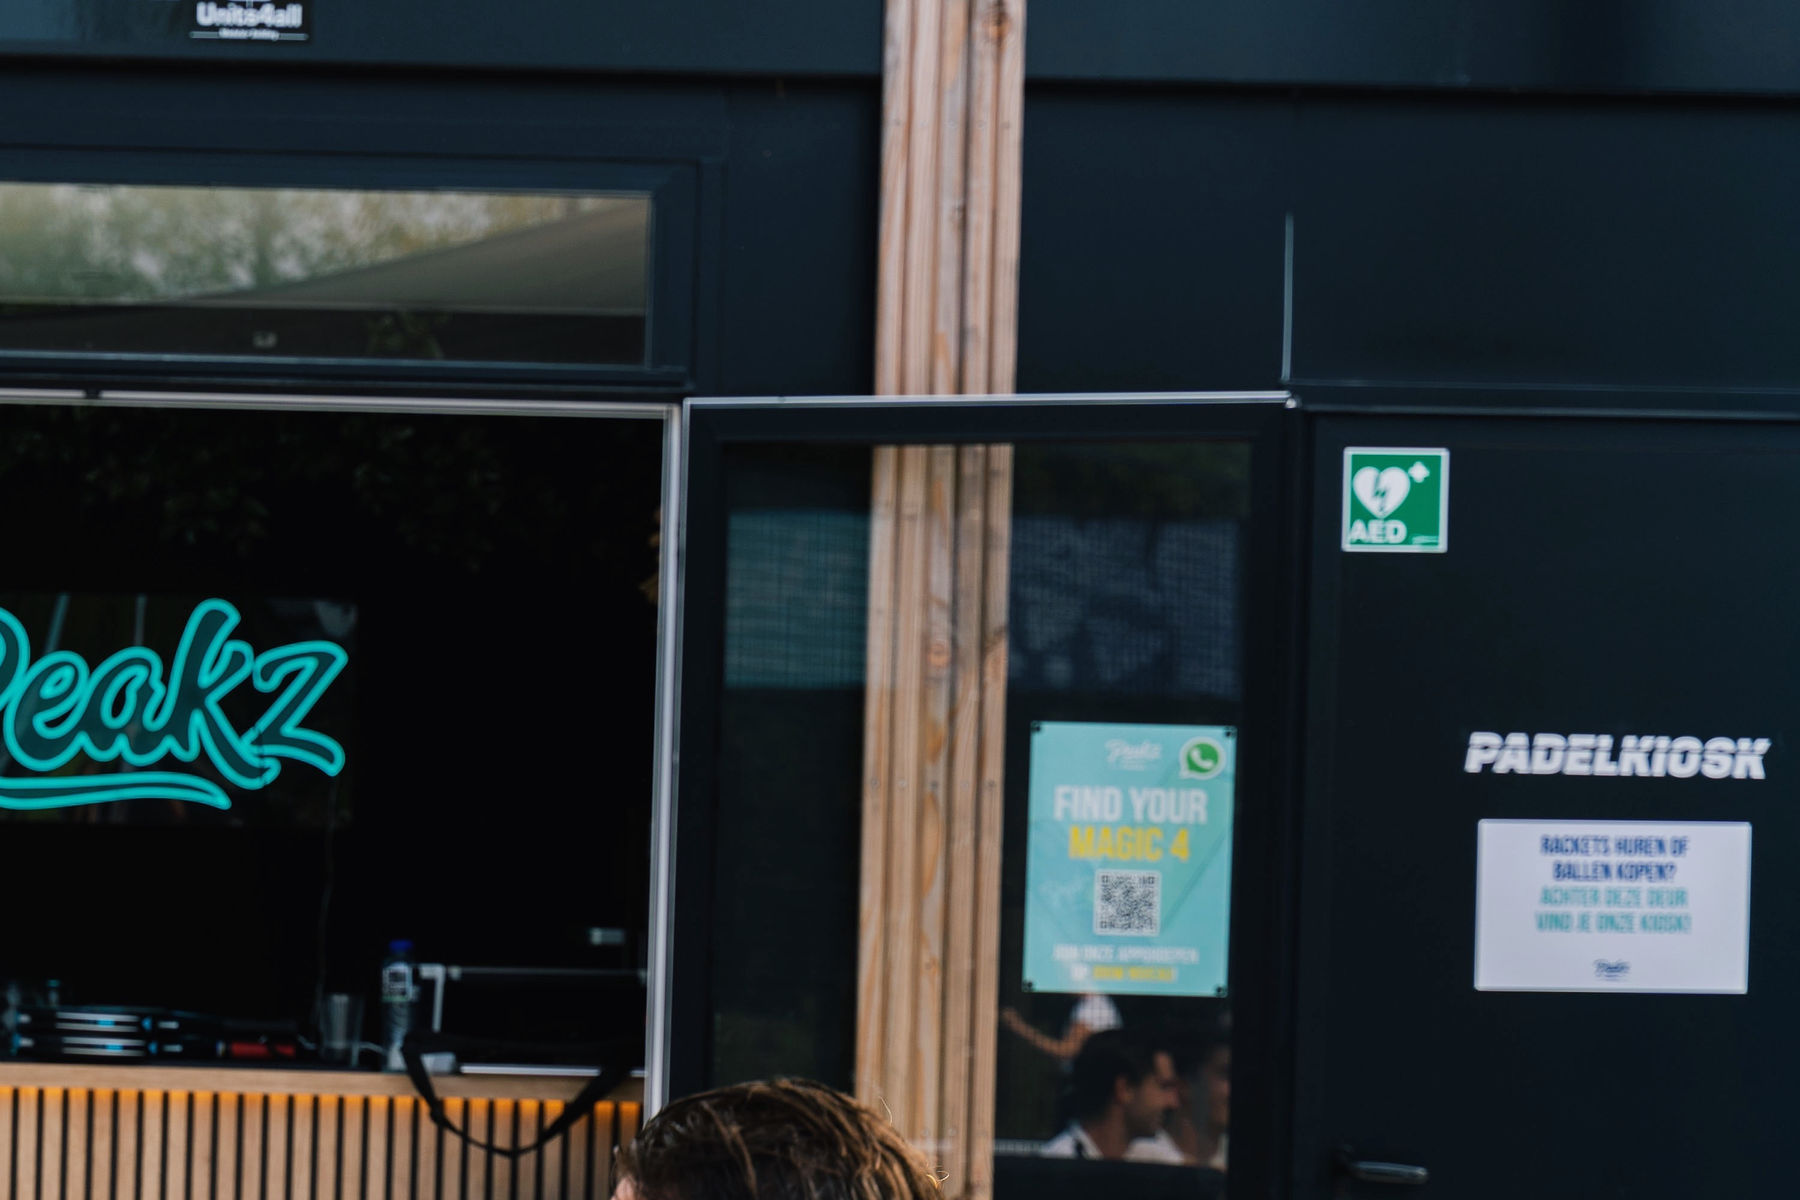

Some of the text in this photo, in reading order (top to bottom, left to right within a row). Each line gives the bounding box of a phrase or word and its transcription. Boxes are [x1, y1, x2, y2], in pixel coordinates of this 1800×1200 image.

[196, 2, 303, 27] Units4all
[1349, 519, 1408, 544] AED
[1464, 731, 1771, 779] PADELKIOSK
[1053, 784, 1208, 825] FIND YOUR
[1068, 825, 1190, 862] MAGIC 4
[1541, 835, 1688, 857] RACKETS HUREN OF
[1554, 860, 1676, 882] BALLEN KOPEN?
[1540, 886, 1688, 907] ACHTER DEZE DEUR
[1536, 912, 1572, 933] VIND
[1578, 913, 1590, 933] JE
[1597, 913, 1634, 933] ONZE
